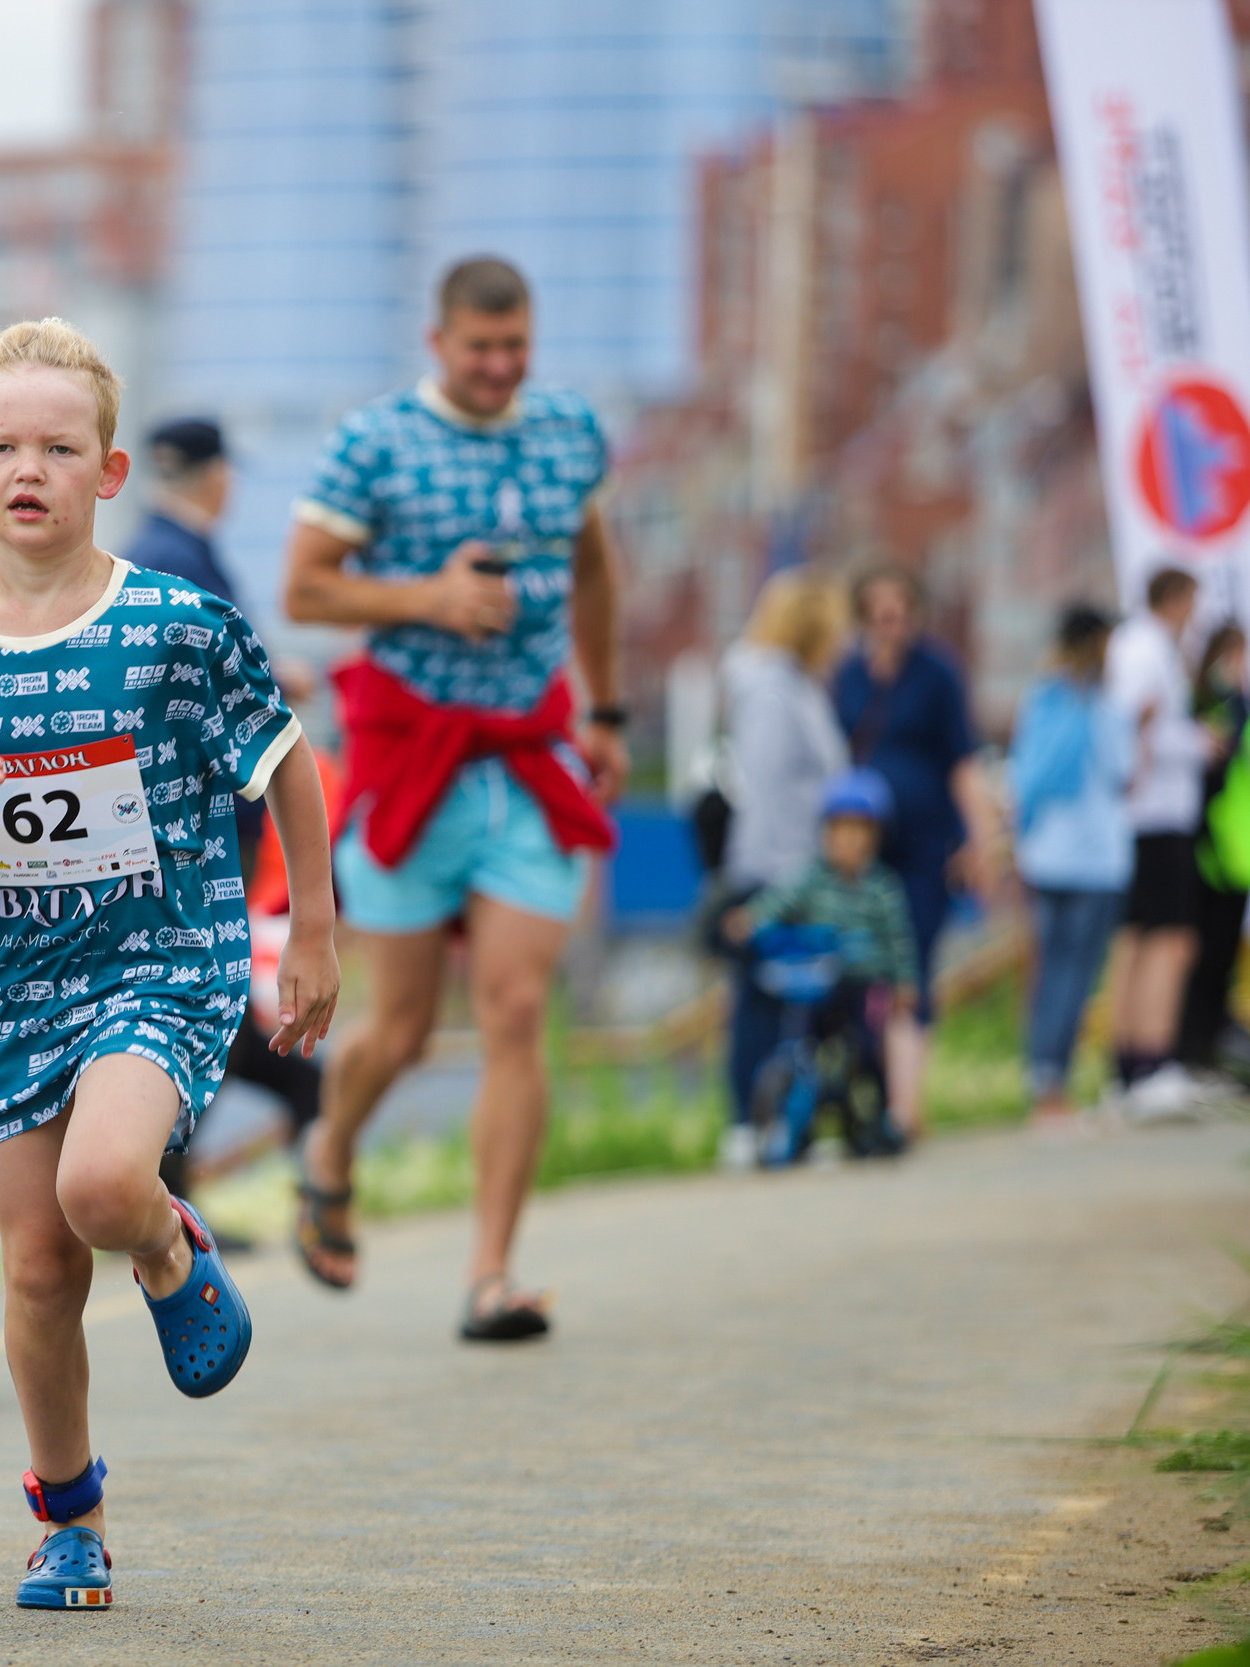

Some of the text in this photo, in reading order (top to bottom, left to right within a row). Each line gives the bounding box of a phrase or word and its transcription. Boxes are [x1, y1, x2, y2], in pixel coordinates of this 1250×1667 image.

[124, 677, 163, 687] TRIATHLON
[21, 684, 46, 693] TEAM
[76, 713, 99, 721] IRON
[77, 722, 102, 730] TEAM
[3, 789, 88, 844] 62
[217, 880, 238, 889] IRON
[218, 889, 243, 897] TEAM
[180, 938, 204, 946] TEAM
[75, 1006, 93, 1015] IRON
